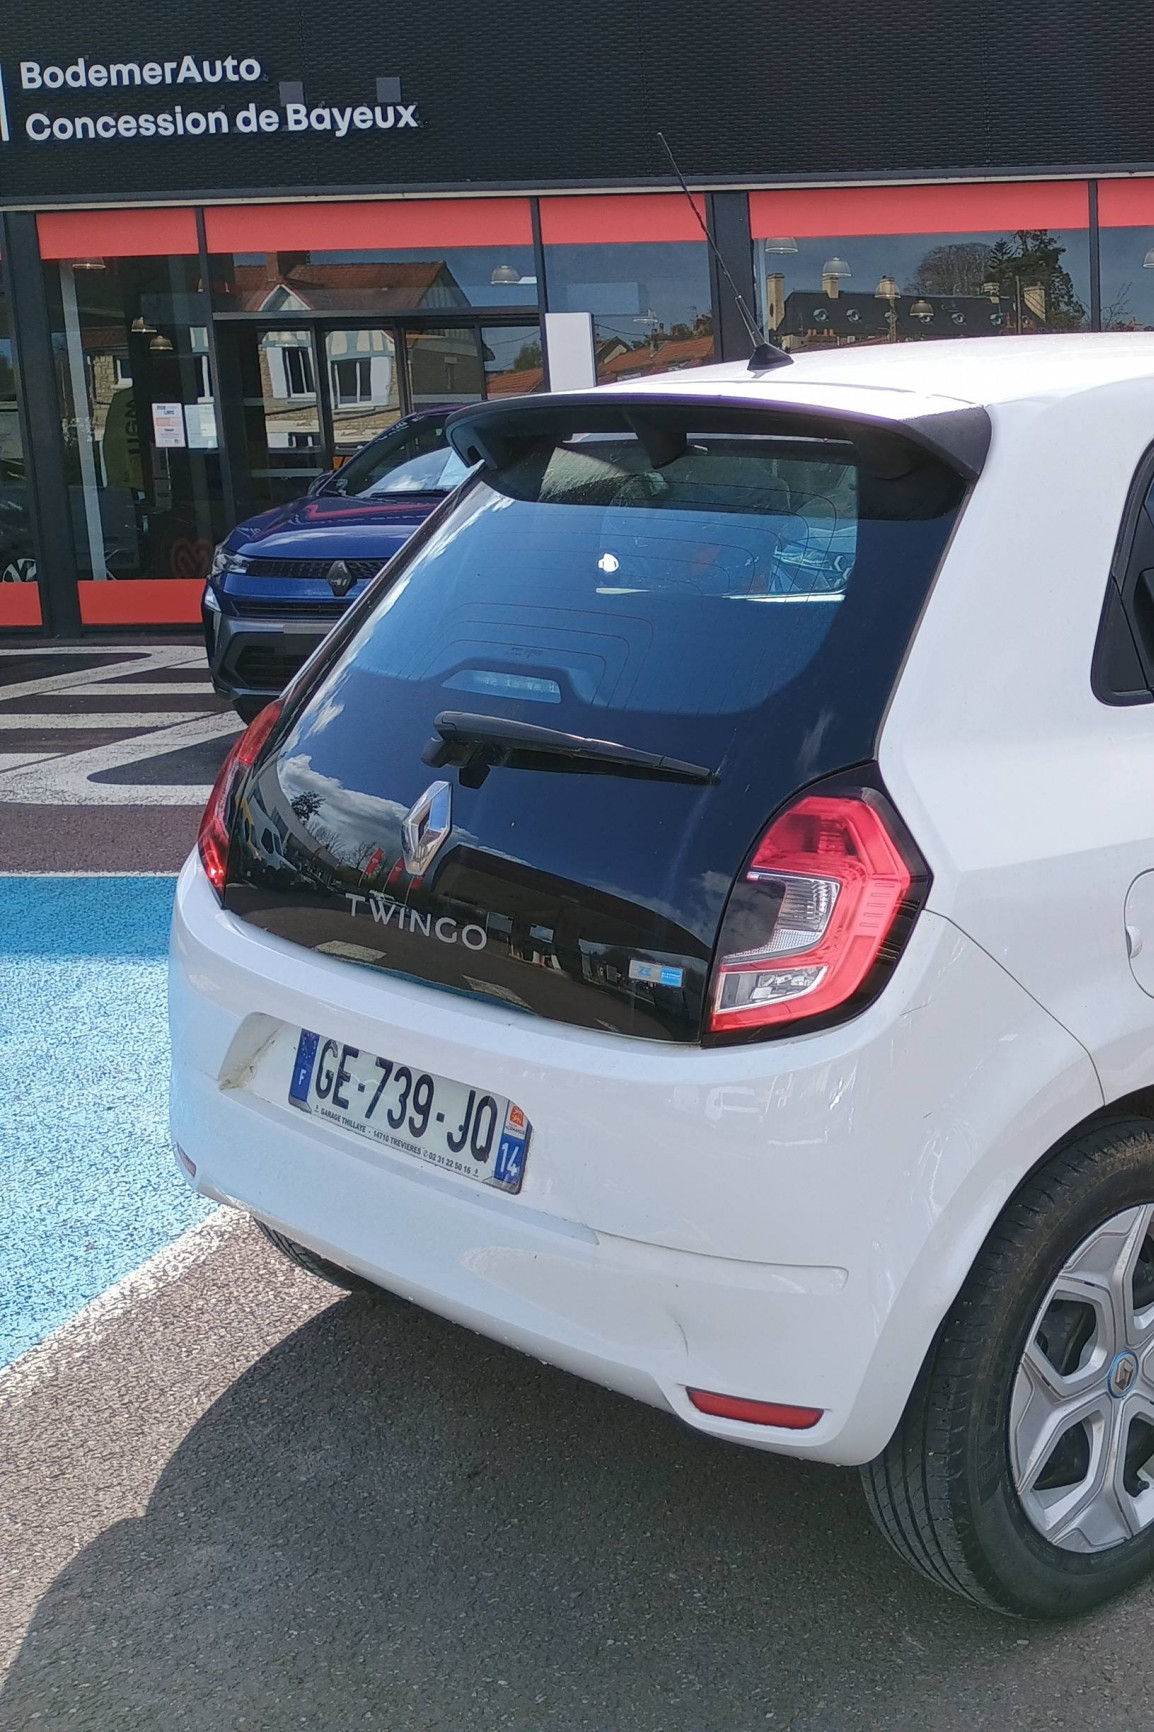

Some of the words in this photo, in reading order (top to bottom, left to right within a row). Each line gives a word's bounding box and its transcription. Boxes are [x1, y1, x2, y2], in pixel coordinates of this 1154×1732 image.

[20, 55, 262, 89] BodemerAuto
[25, 105, 229, 141] Concession
[236, 103, 279, 132] de
[286, 101, 419, 137] Bayeux
[345, 893, 487, 951] TWINGO
[298, 1068, 307, 1086] F
[320, 1107, 341, 1122] GARAGE
[428, 1152, 437, 1161] 02
[437, 1155, 445, 1165] 31
[445, 1158, 454, 1168] 22
[501, 1142, 520, 1177] 14
